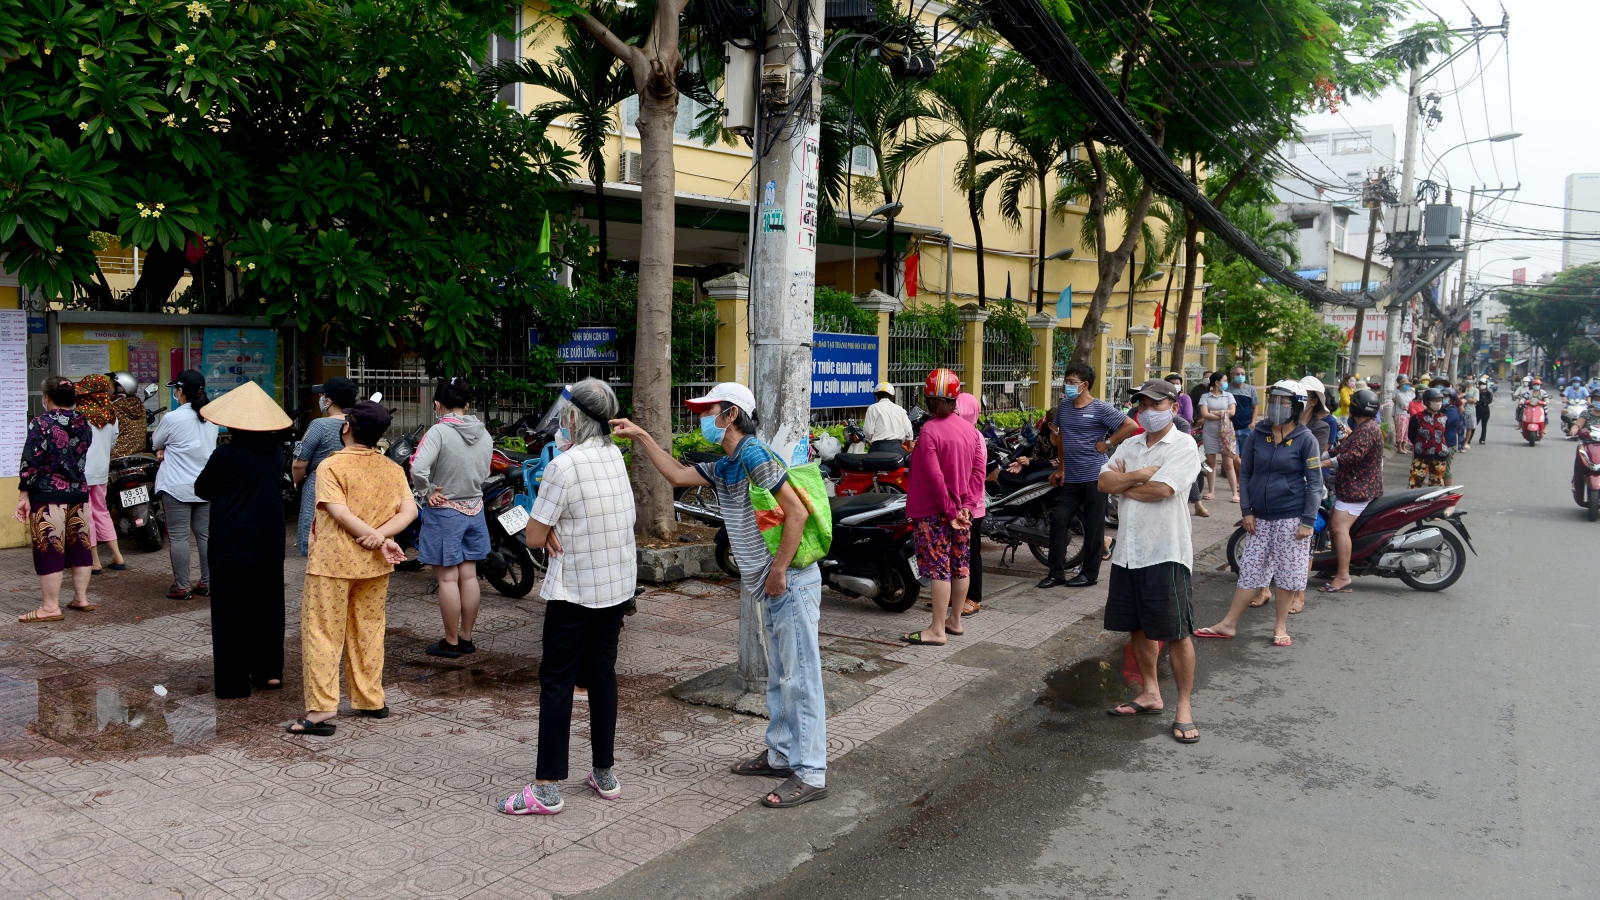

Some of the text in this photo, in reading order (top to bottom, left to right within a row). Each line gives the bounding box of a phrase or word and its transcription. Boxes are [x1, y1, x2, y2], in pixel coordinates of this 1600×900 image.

[562, 348, 570, 358] XE
[818, 359, 835, 374] THỨC
[836, 362, 851, 374] GIAO
[852, 361, 872, 375] THÔNG
[814, 381, 822, 396] NỤ
[824, 378, 840, 394] CƯỜI
[840, 381, 857, 396] HẠNH
[858, 379, 874, 394] PHÚC
